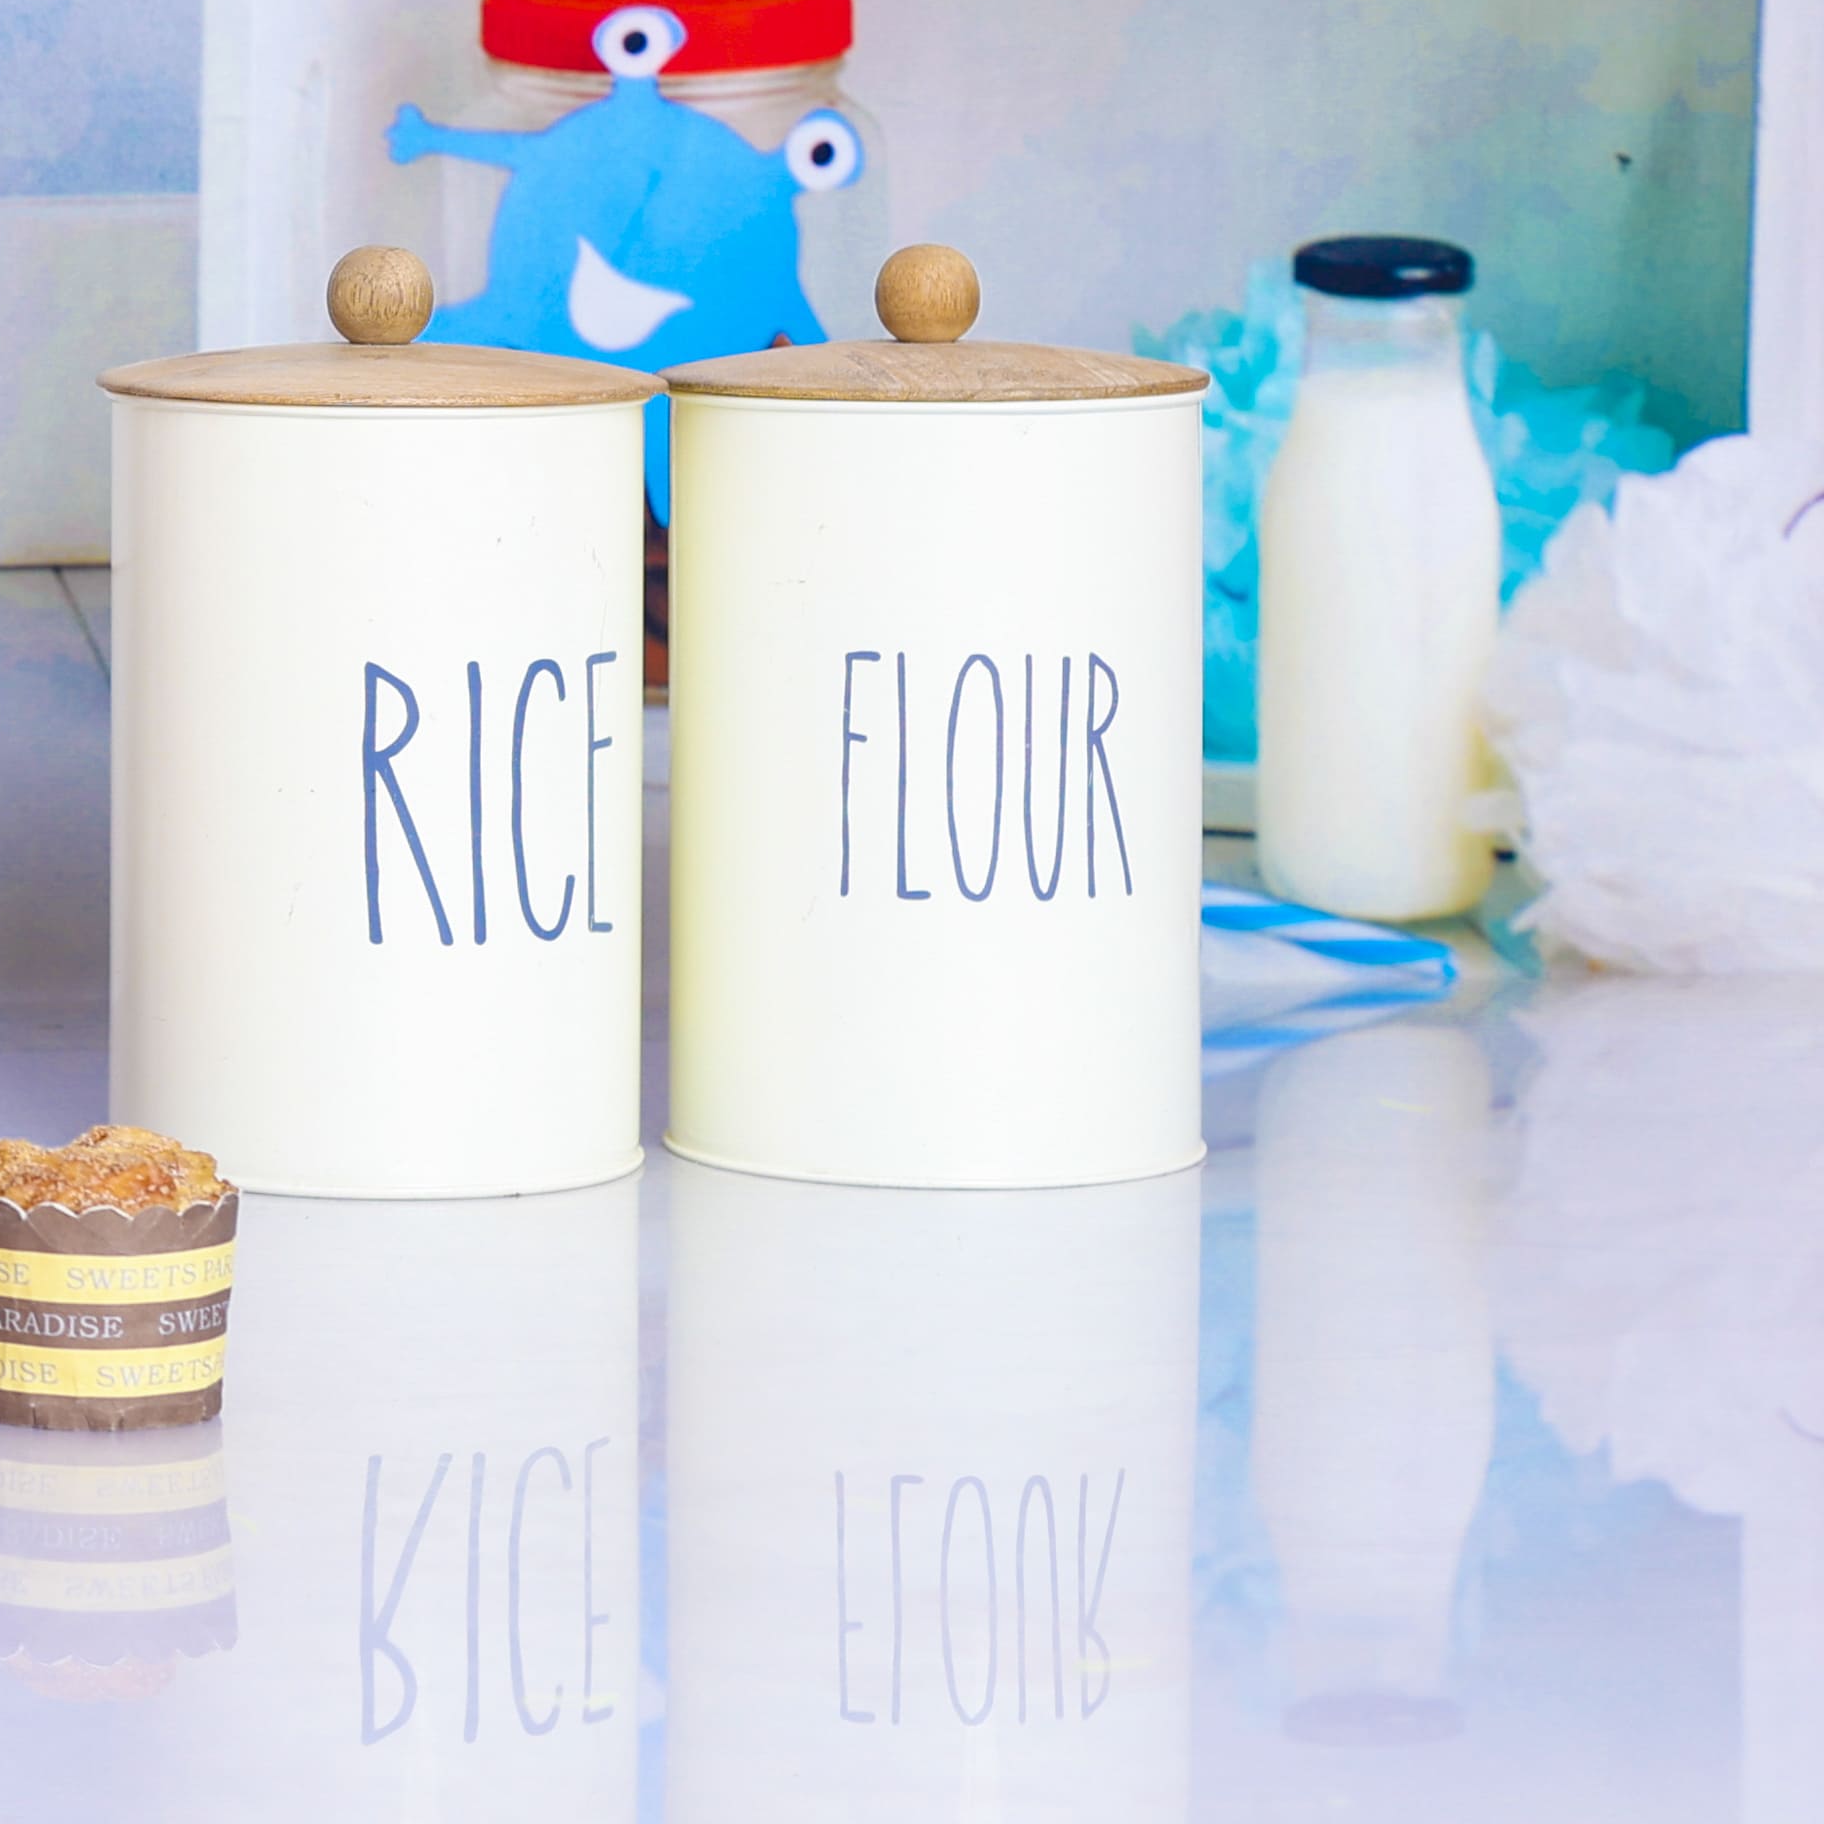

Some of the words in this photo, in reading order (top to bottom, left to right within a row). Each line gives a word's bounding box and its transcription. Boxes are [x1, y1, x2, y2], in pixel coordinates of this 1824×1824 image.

[361, 650, 617, 946] RICE
[838, 650, 1133, 902] FLOUR
[66, 1262, 198, 1291] SWEETS
[95, 1354, 213, 1389] SWEETS
